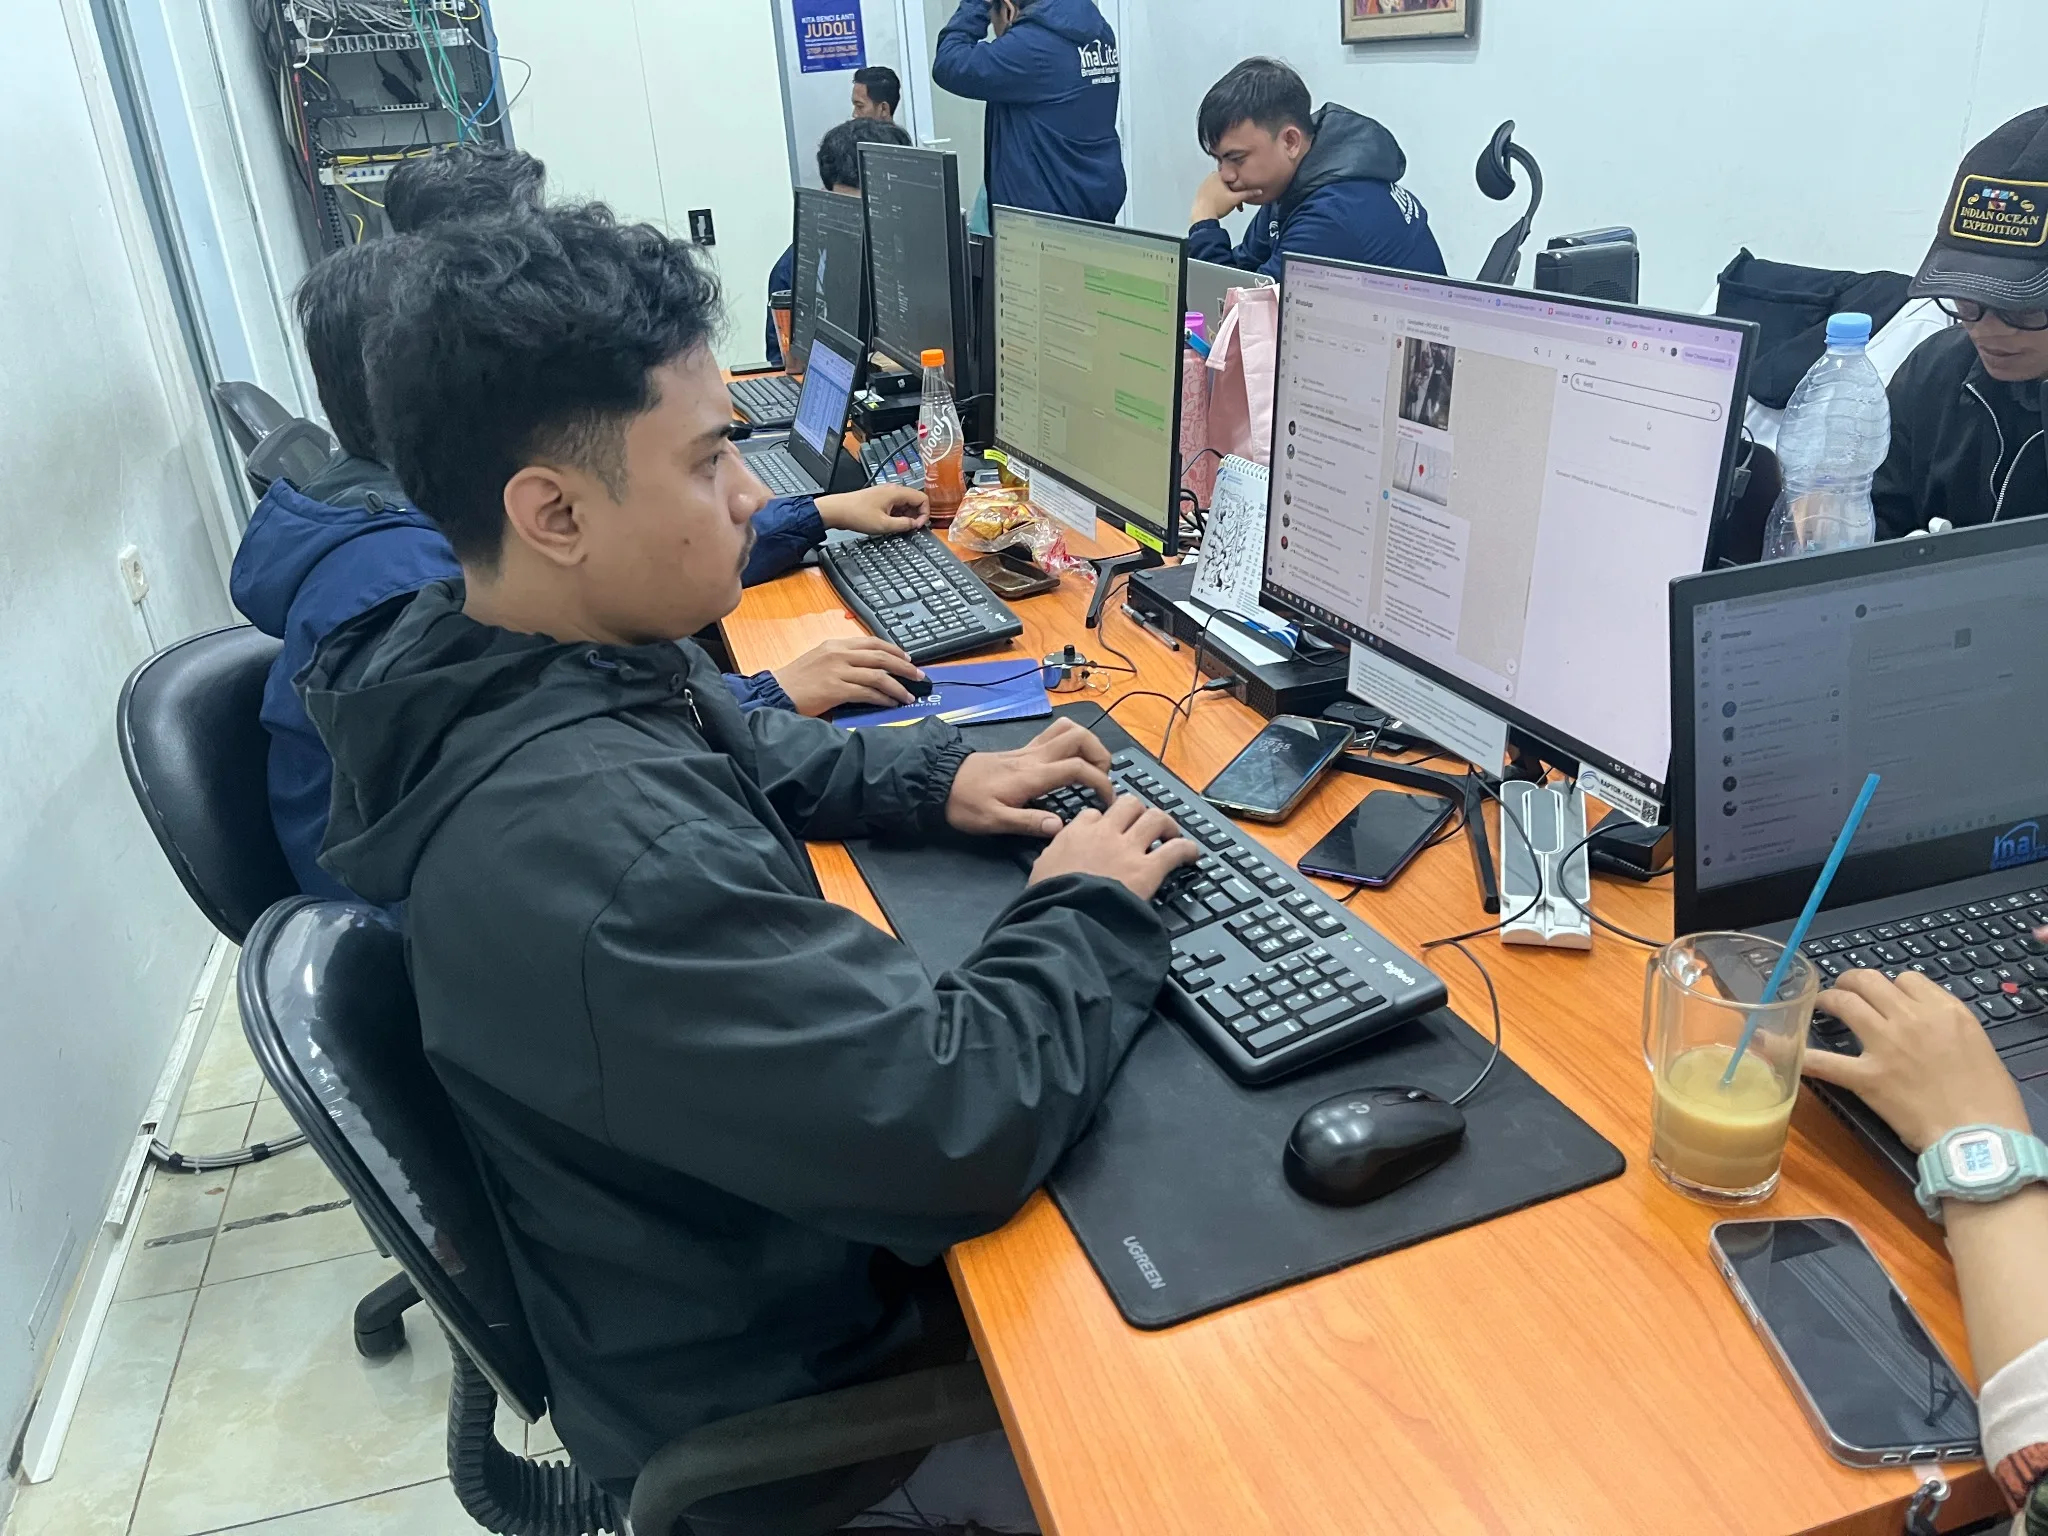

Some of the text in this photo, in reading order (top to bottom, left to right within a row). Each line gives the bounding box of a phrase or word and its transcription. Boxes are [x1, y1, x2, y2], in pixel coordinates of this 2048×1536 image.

[804, 20, 856, 38] JUDOL!
[1961, 207, 2039, 225] INDIAN OCEAN
[1962, 220, 2029, 236] EXPEDITION
[1383, 960, 1416, 986] logitech
[1122, 1235, 1167, 1290] UGREEN
